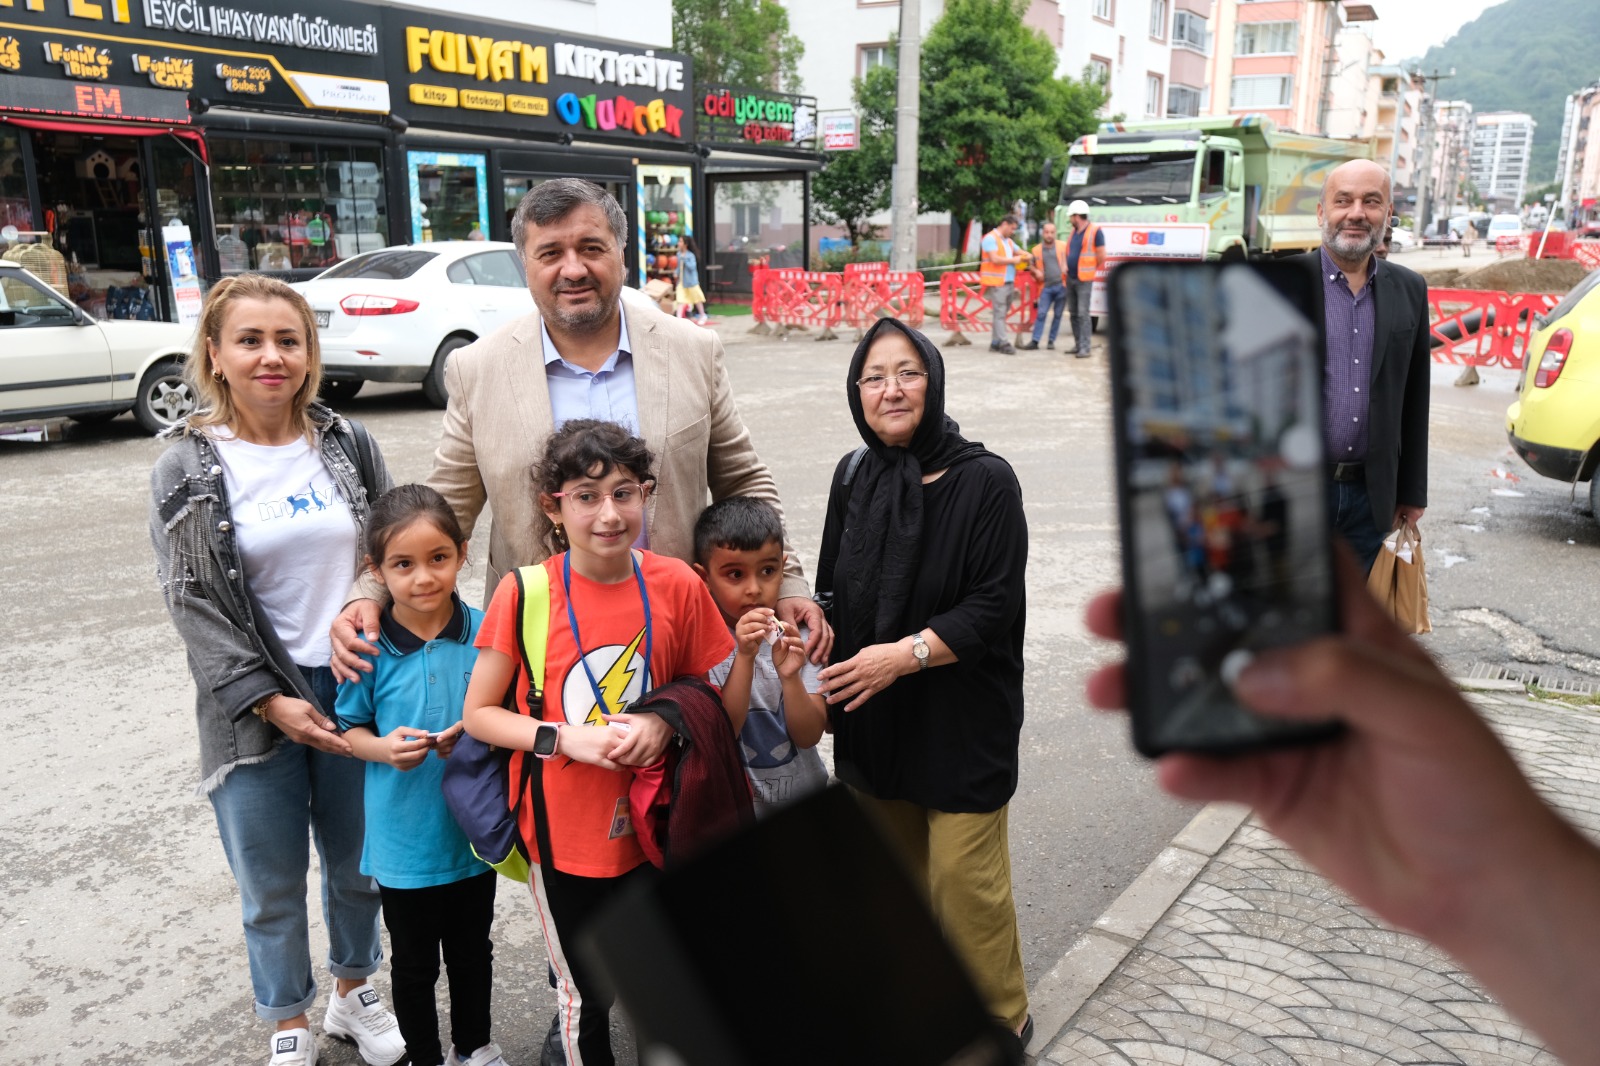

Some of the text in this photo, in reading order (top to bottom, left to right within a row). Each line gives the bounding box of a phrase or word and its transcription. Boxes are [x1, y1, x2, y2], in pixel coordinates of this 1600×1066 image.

[150, 0, 210, 32] EVCİL
[216, 8, 293, 43] HAYVAN
[298, 16, 378, 54] ÜRÜNLERİ
[222, 64, 247, 79] Since
[554, 42, 685, 92] KIRTASİYE
[75, 85, 122, 114] EM
[556, 92, 684, 138] OYUNCAK
